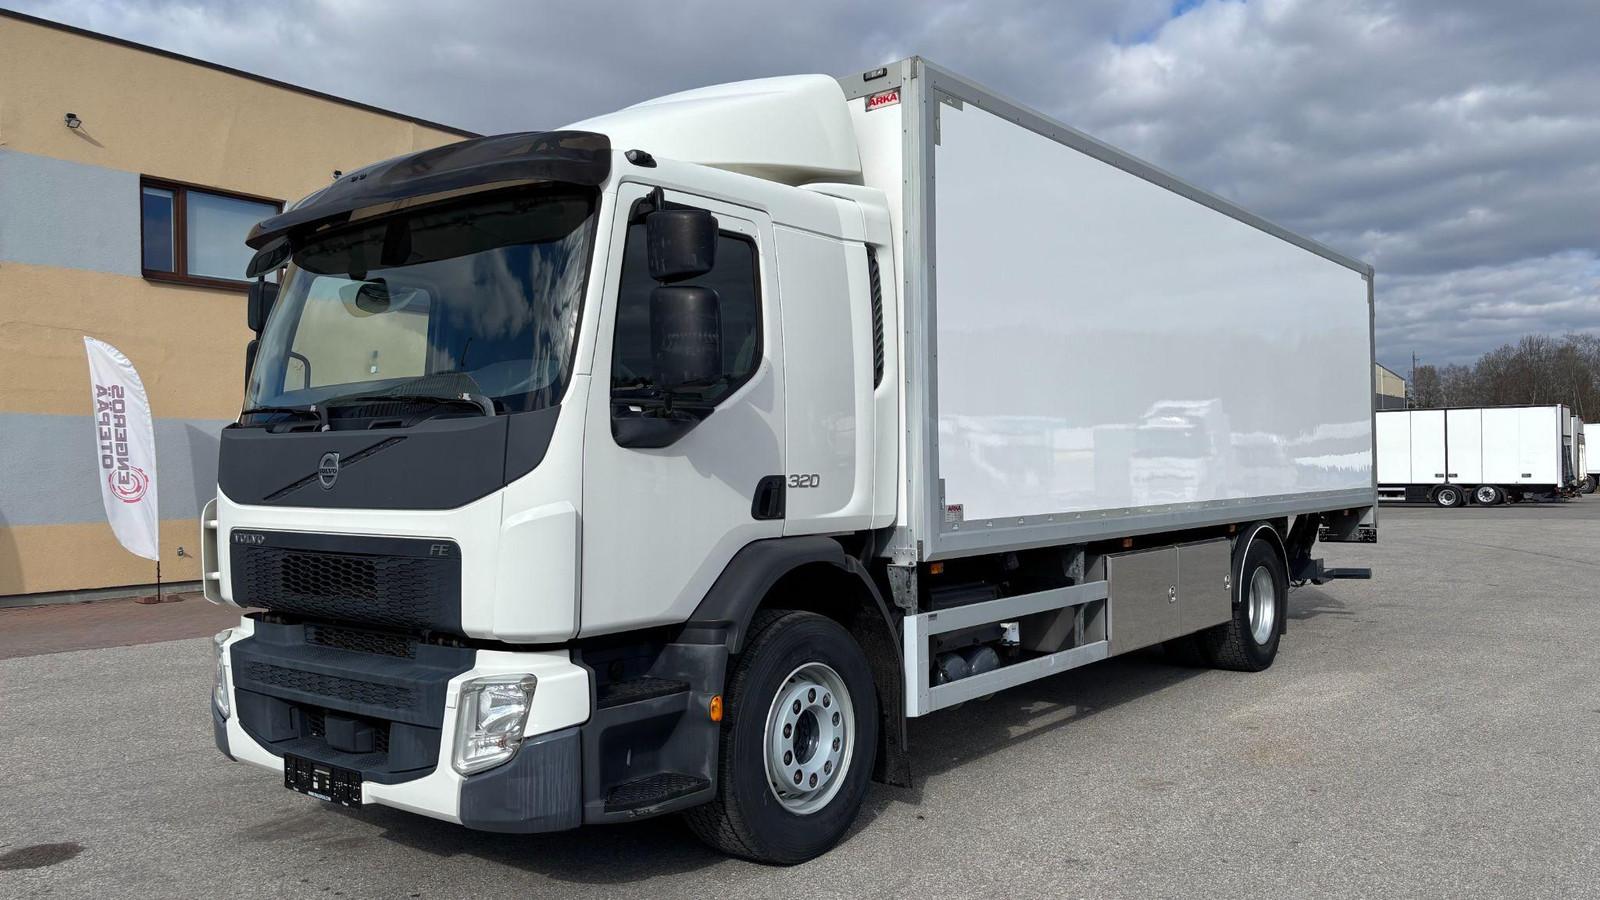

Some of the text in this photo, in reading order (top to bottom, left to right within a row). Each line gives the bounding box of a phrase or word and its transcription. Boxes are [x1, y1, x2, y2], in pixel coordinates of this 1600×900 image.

[868, 93, 898, 107] ARKA
[788, 474, 820, 488] 320
[234, 533, 265, 544] VOLVO
[430, 544, 449, 556] FE
